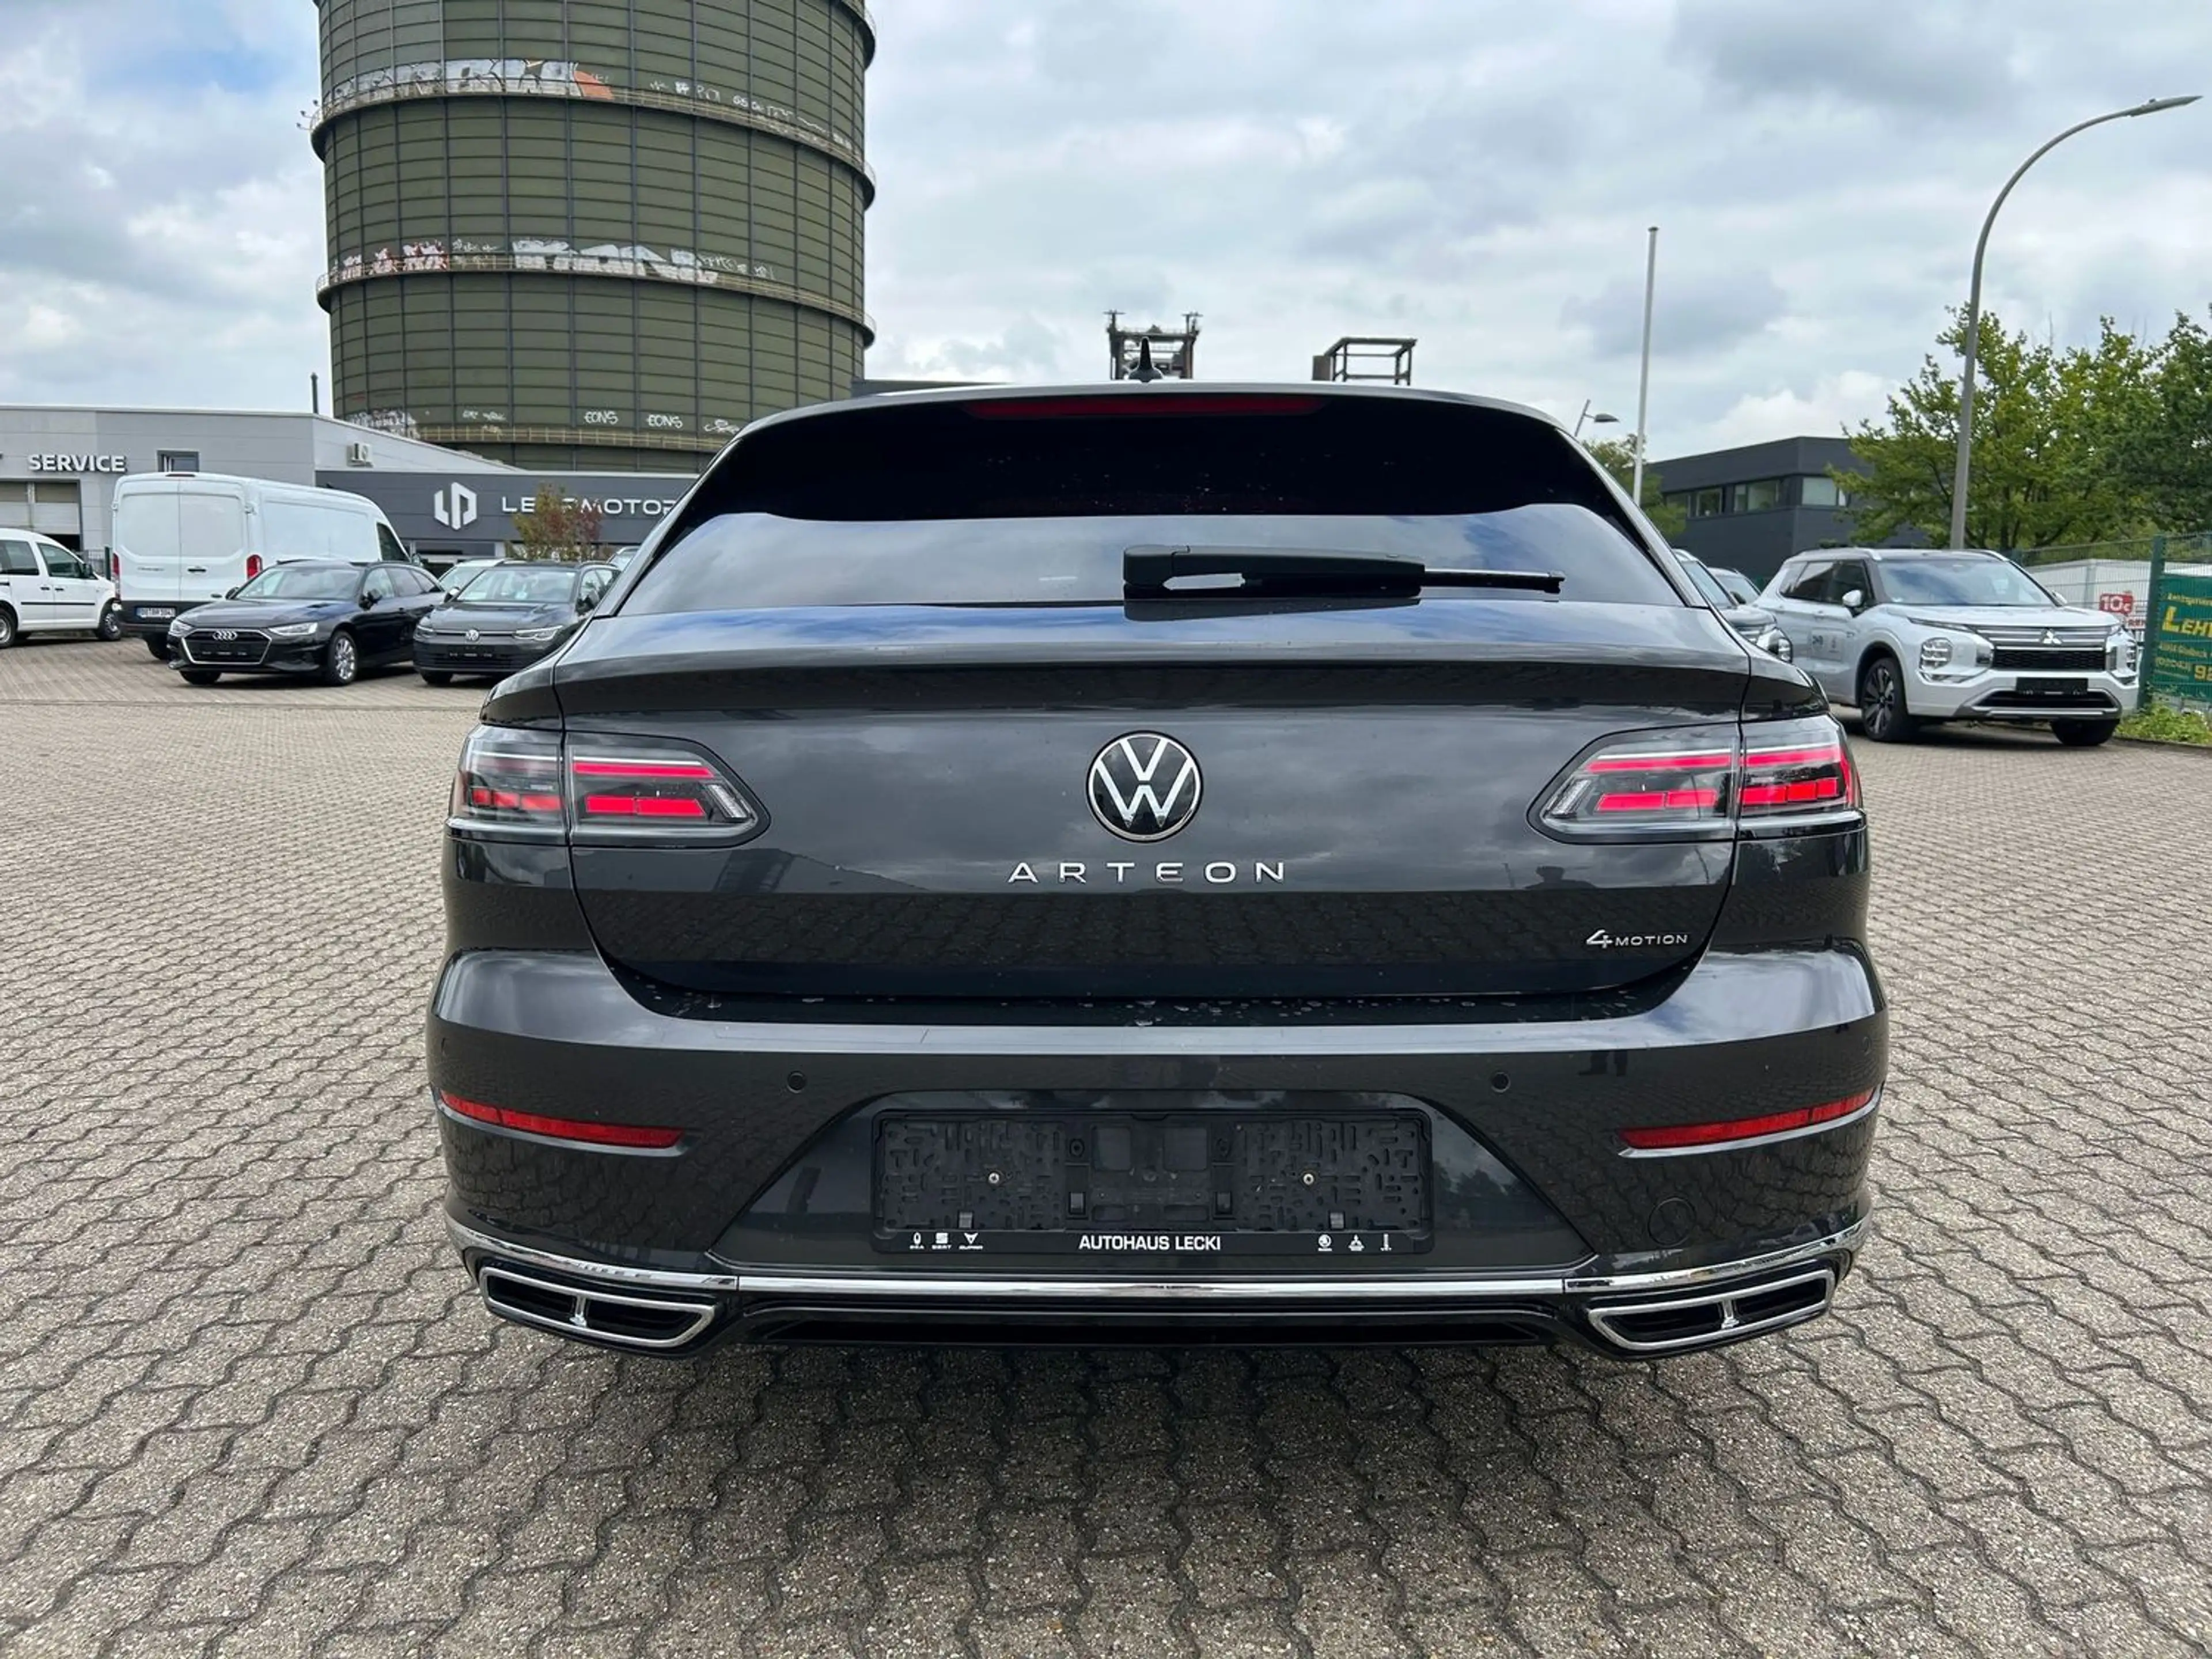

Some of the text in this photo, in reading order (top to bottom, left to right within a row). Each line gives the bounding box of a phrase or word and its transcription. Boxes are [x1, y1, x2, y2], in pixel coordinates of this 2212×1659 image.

[28, 454, 126, 472] SERVICE
[1007, 862, 1285, 884] ARTEON
[1586, 929, 1688, 949] 4MOTION
[1078, 1234, 1221, 1251] AUTOHAUS LECKI
